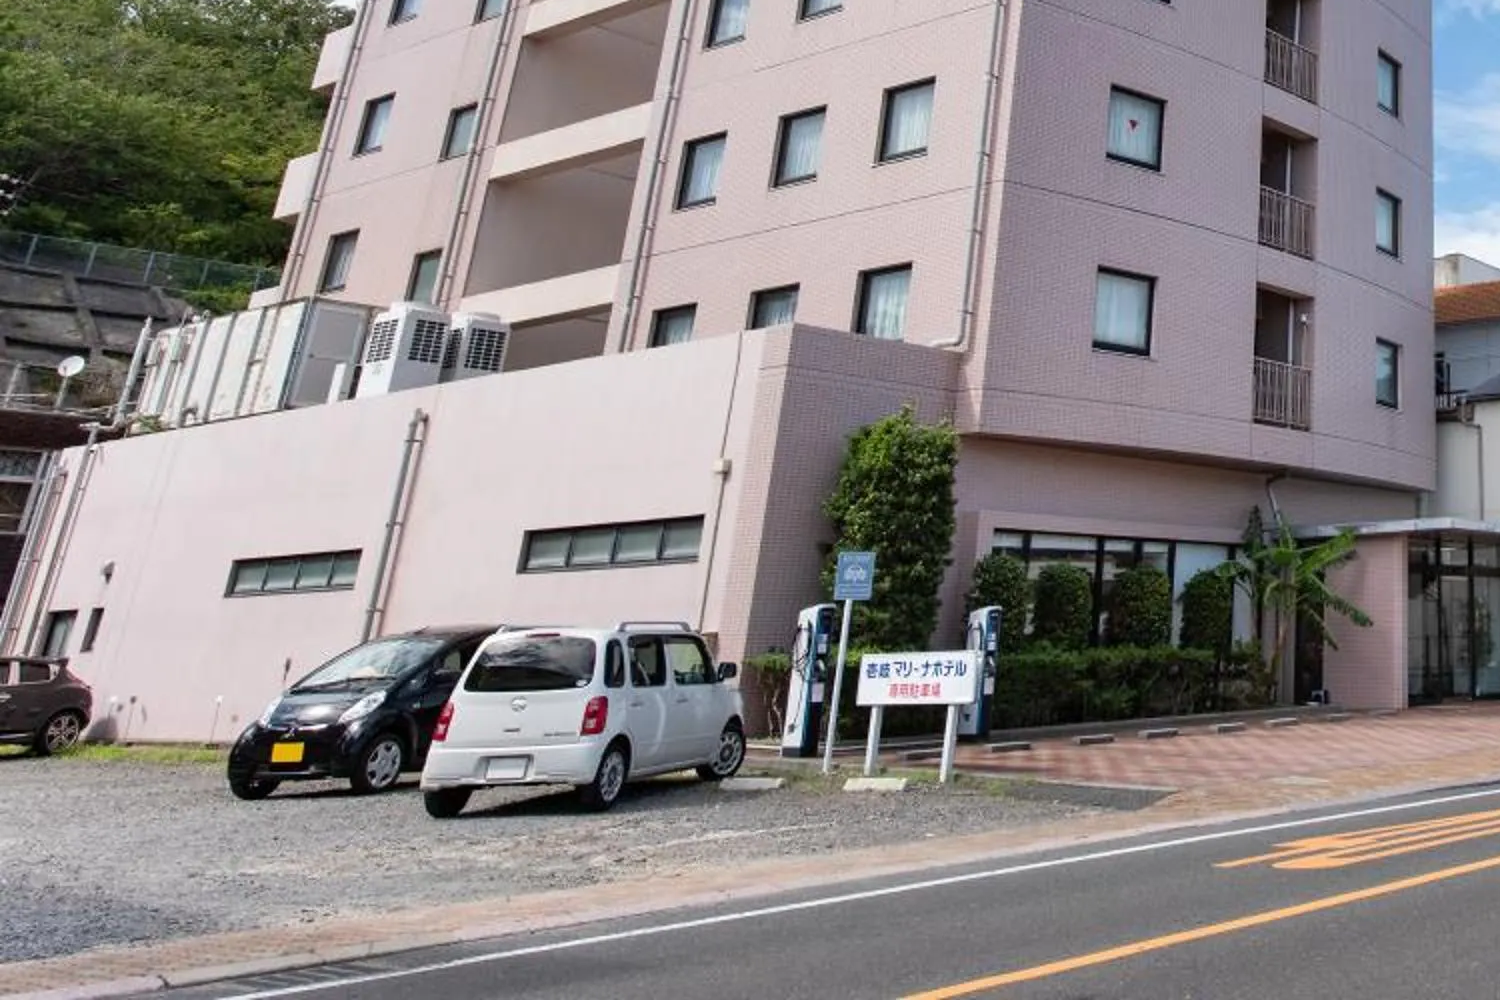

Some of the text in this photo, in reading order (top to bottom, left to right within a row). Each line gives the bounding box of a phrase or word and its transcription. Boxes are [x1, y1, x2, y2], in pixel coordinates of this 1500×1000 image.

[866, 660, 967, 679] 壱岐マリーナホテル
